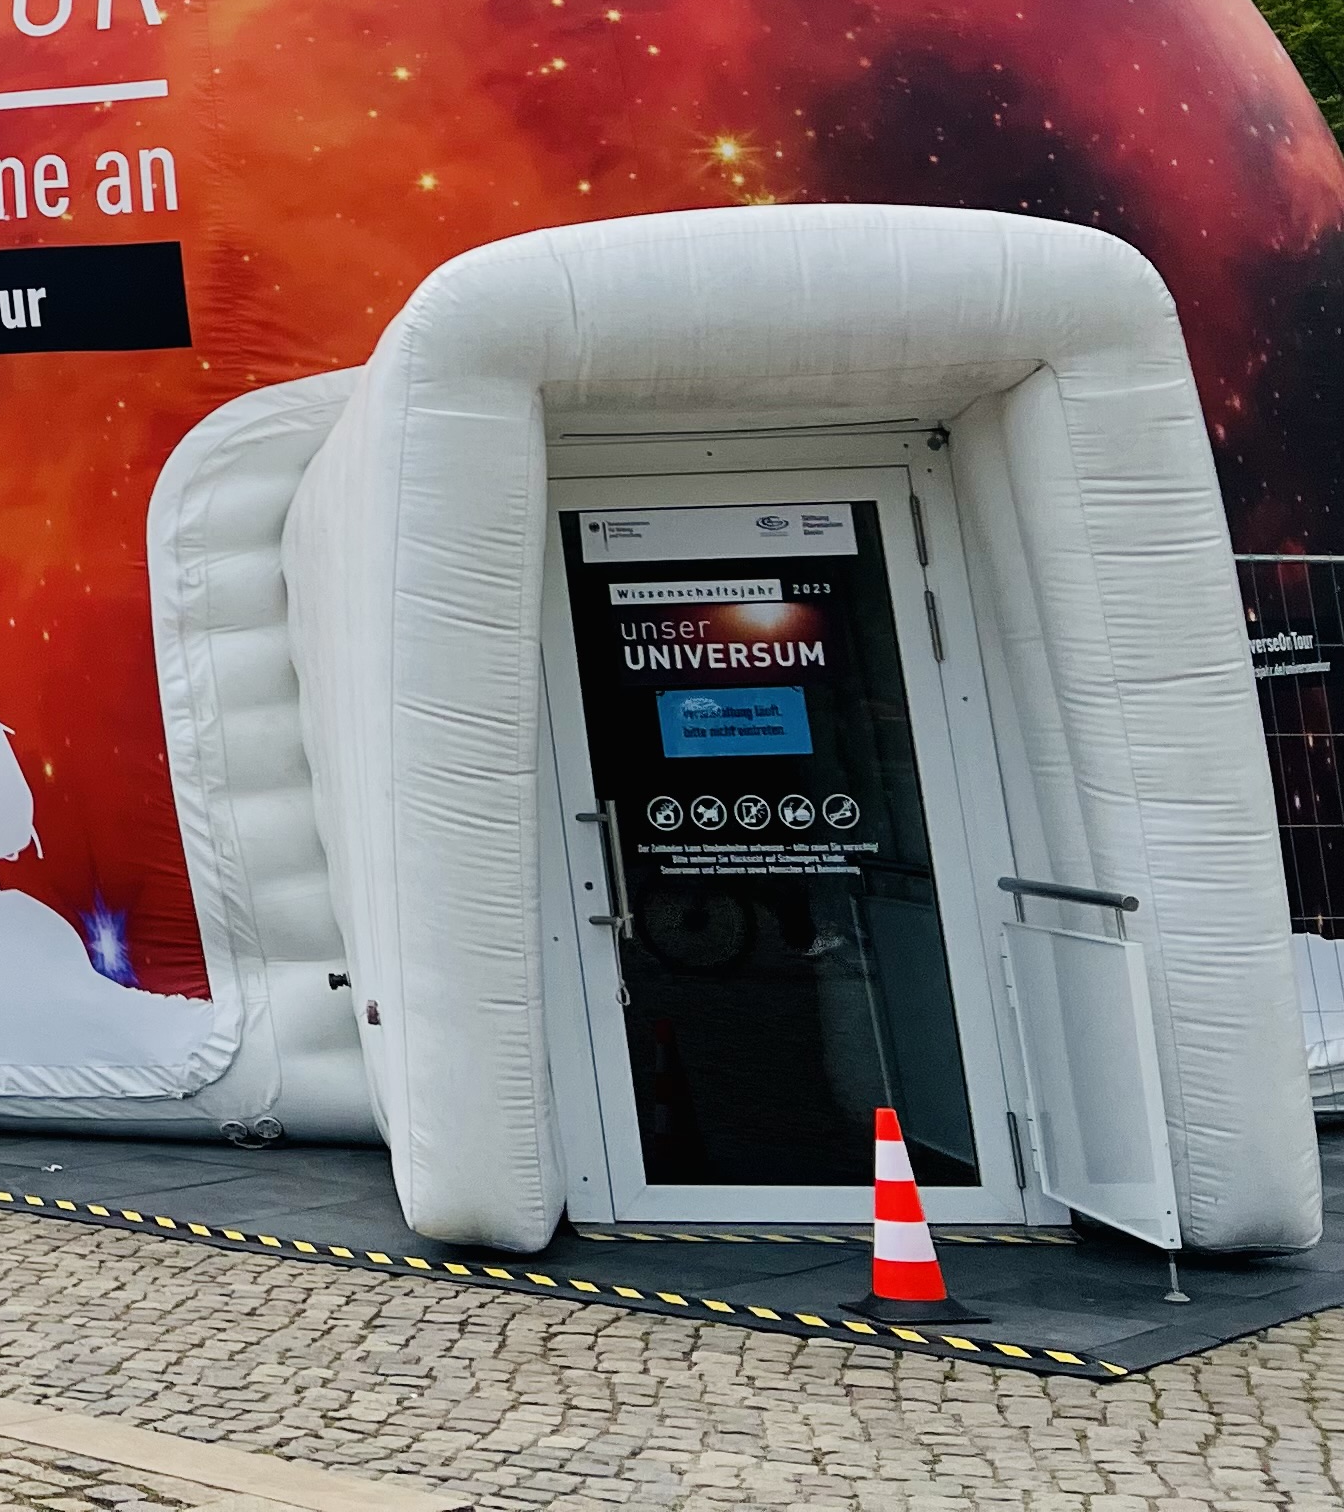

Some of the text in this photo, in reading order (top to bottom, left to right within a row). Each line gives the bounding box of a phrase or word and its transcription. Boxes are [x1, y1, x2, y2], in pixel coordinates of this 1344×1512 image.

[96, 147, 178, 215] an
[616, 583, 832, 600] Wissenschaftsjahr 2023
[620, 619, 711, 641] unser
[1249, 631, 1313, 655] verseOnTour
[624, 641, 825, 671] UNIVERSUM
